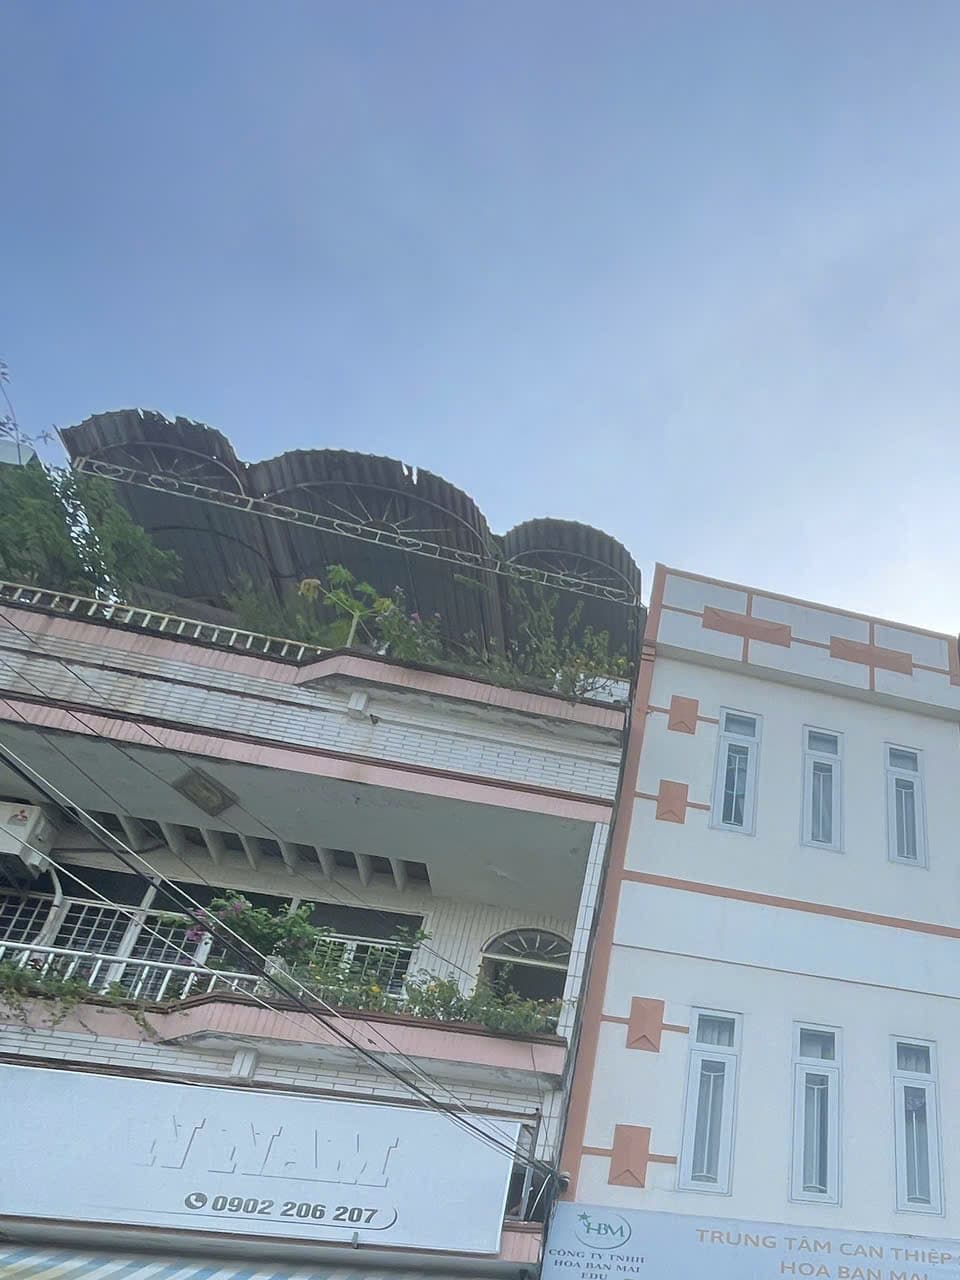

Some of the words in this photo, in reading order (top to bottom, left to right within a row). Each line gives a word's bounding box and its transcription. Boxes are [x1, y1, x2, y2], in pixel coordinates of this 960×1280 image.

[211, 1195, 272, 1215] 0902
[281, 1200, 326, 1219] 206
[333, 1205, 379, 1224] 207
[696, 1229, 778, 1249] TRUNG
[783, 1236, 832, 1254] TÂM
[839, 1242, 884, 1259] CAN
[890, 1247, 953, 1266] THIỆP
[591, 1252, 605, 1260] TY
[609, 1254, 645, 1264] TNHH
[553, 1259, 582, 1269] HOA
[586, 1262, 612, 1271] BAN
[616, 1264, 641, 1273] MAI
[780, 1261, 830, 1278] HOA
[581, 1271, 608, 1280] EDU
